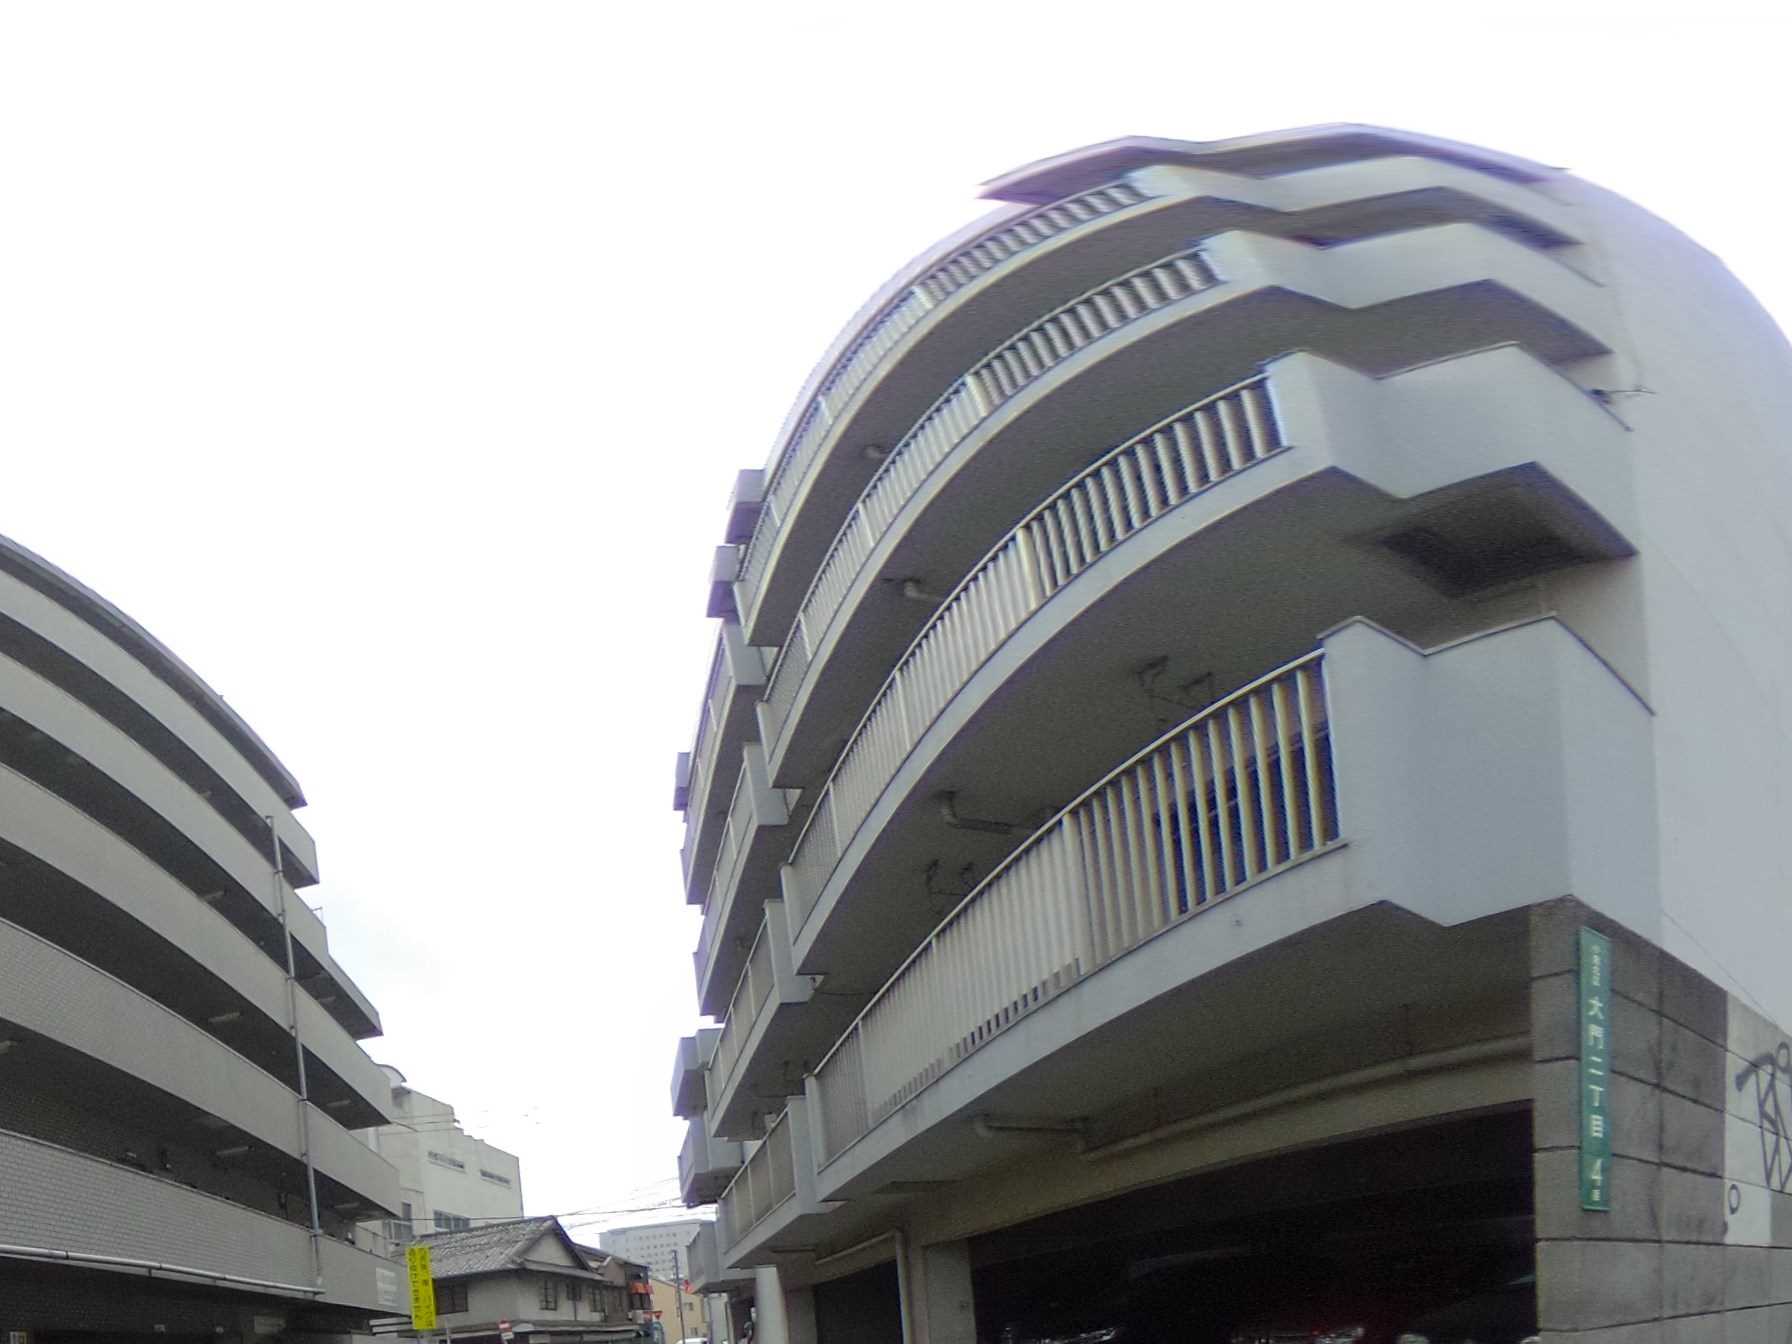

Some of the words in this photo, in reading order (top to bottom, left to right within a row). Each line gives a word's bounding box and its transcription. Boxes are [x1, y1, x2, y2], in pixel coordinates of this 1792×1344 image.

[1588, 996, 1604, 1138] 大門二丁目
